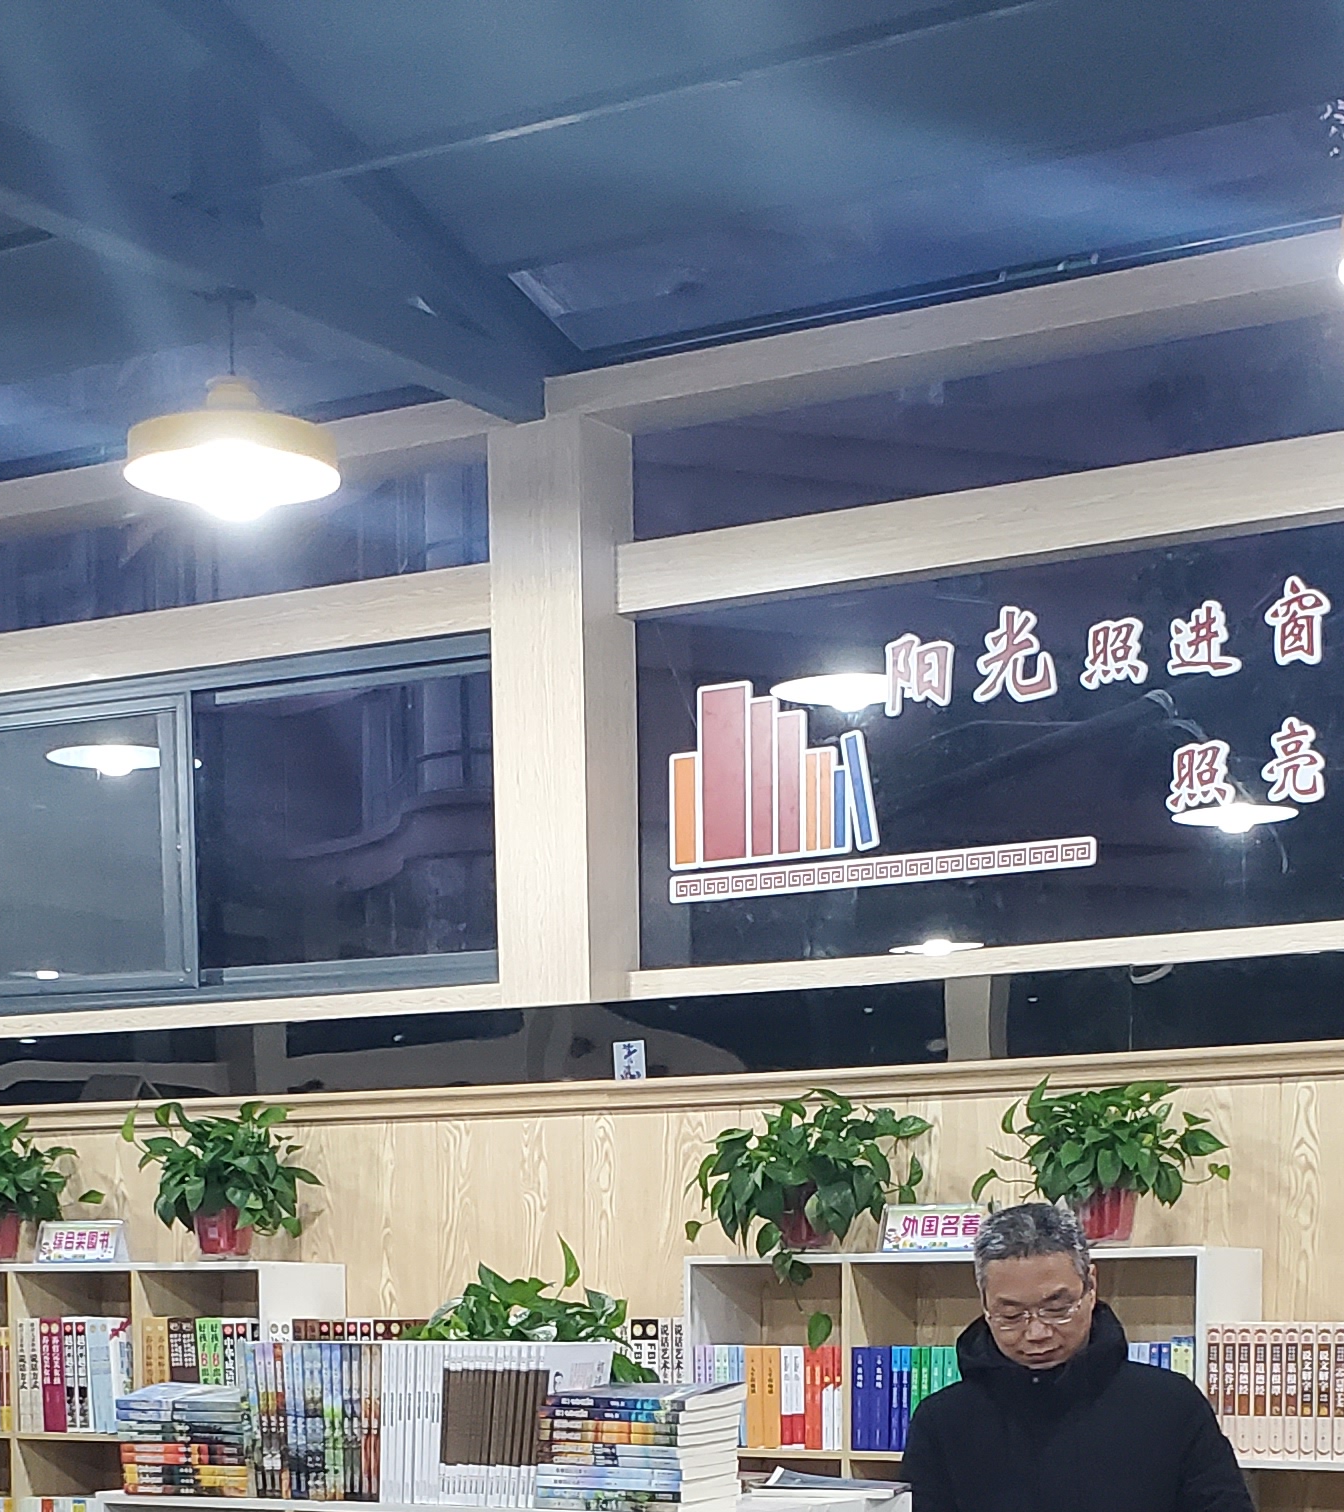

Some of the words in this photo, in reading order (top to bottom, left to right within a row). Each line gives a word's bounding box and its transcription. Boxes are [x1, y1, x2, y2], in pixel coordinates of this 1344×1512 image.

[900, 1214, 981, 1237] 外国名著
[52, 1230, 110, 1250] 综合类图书
